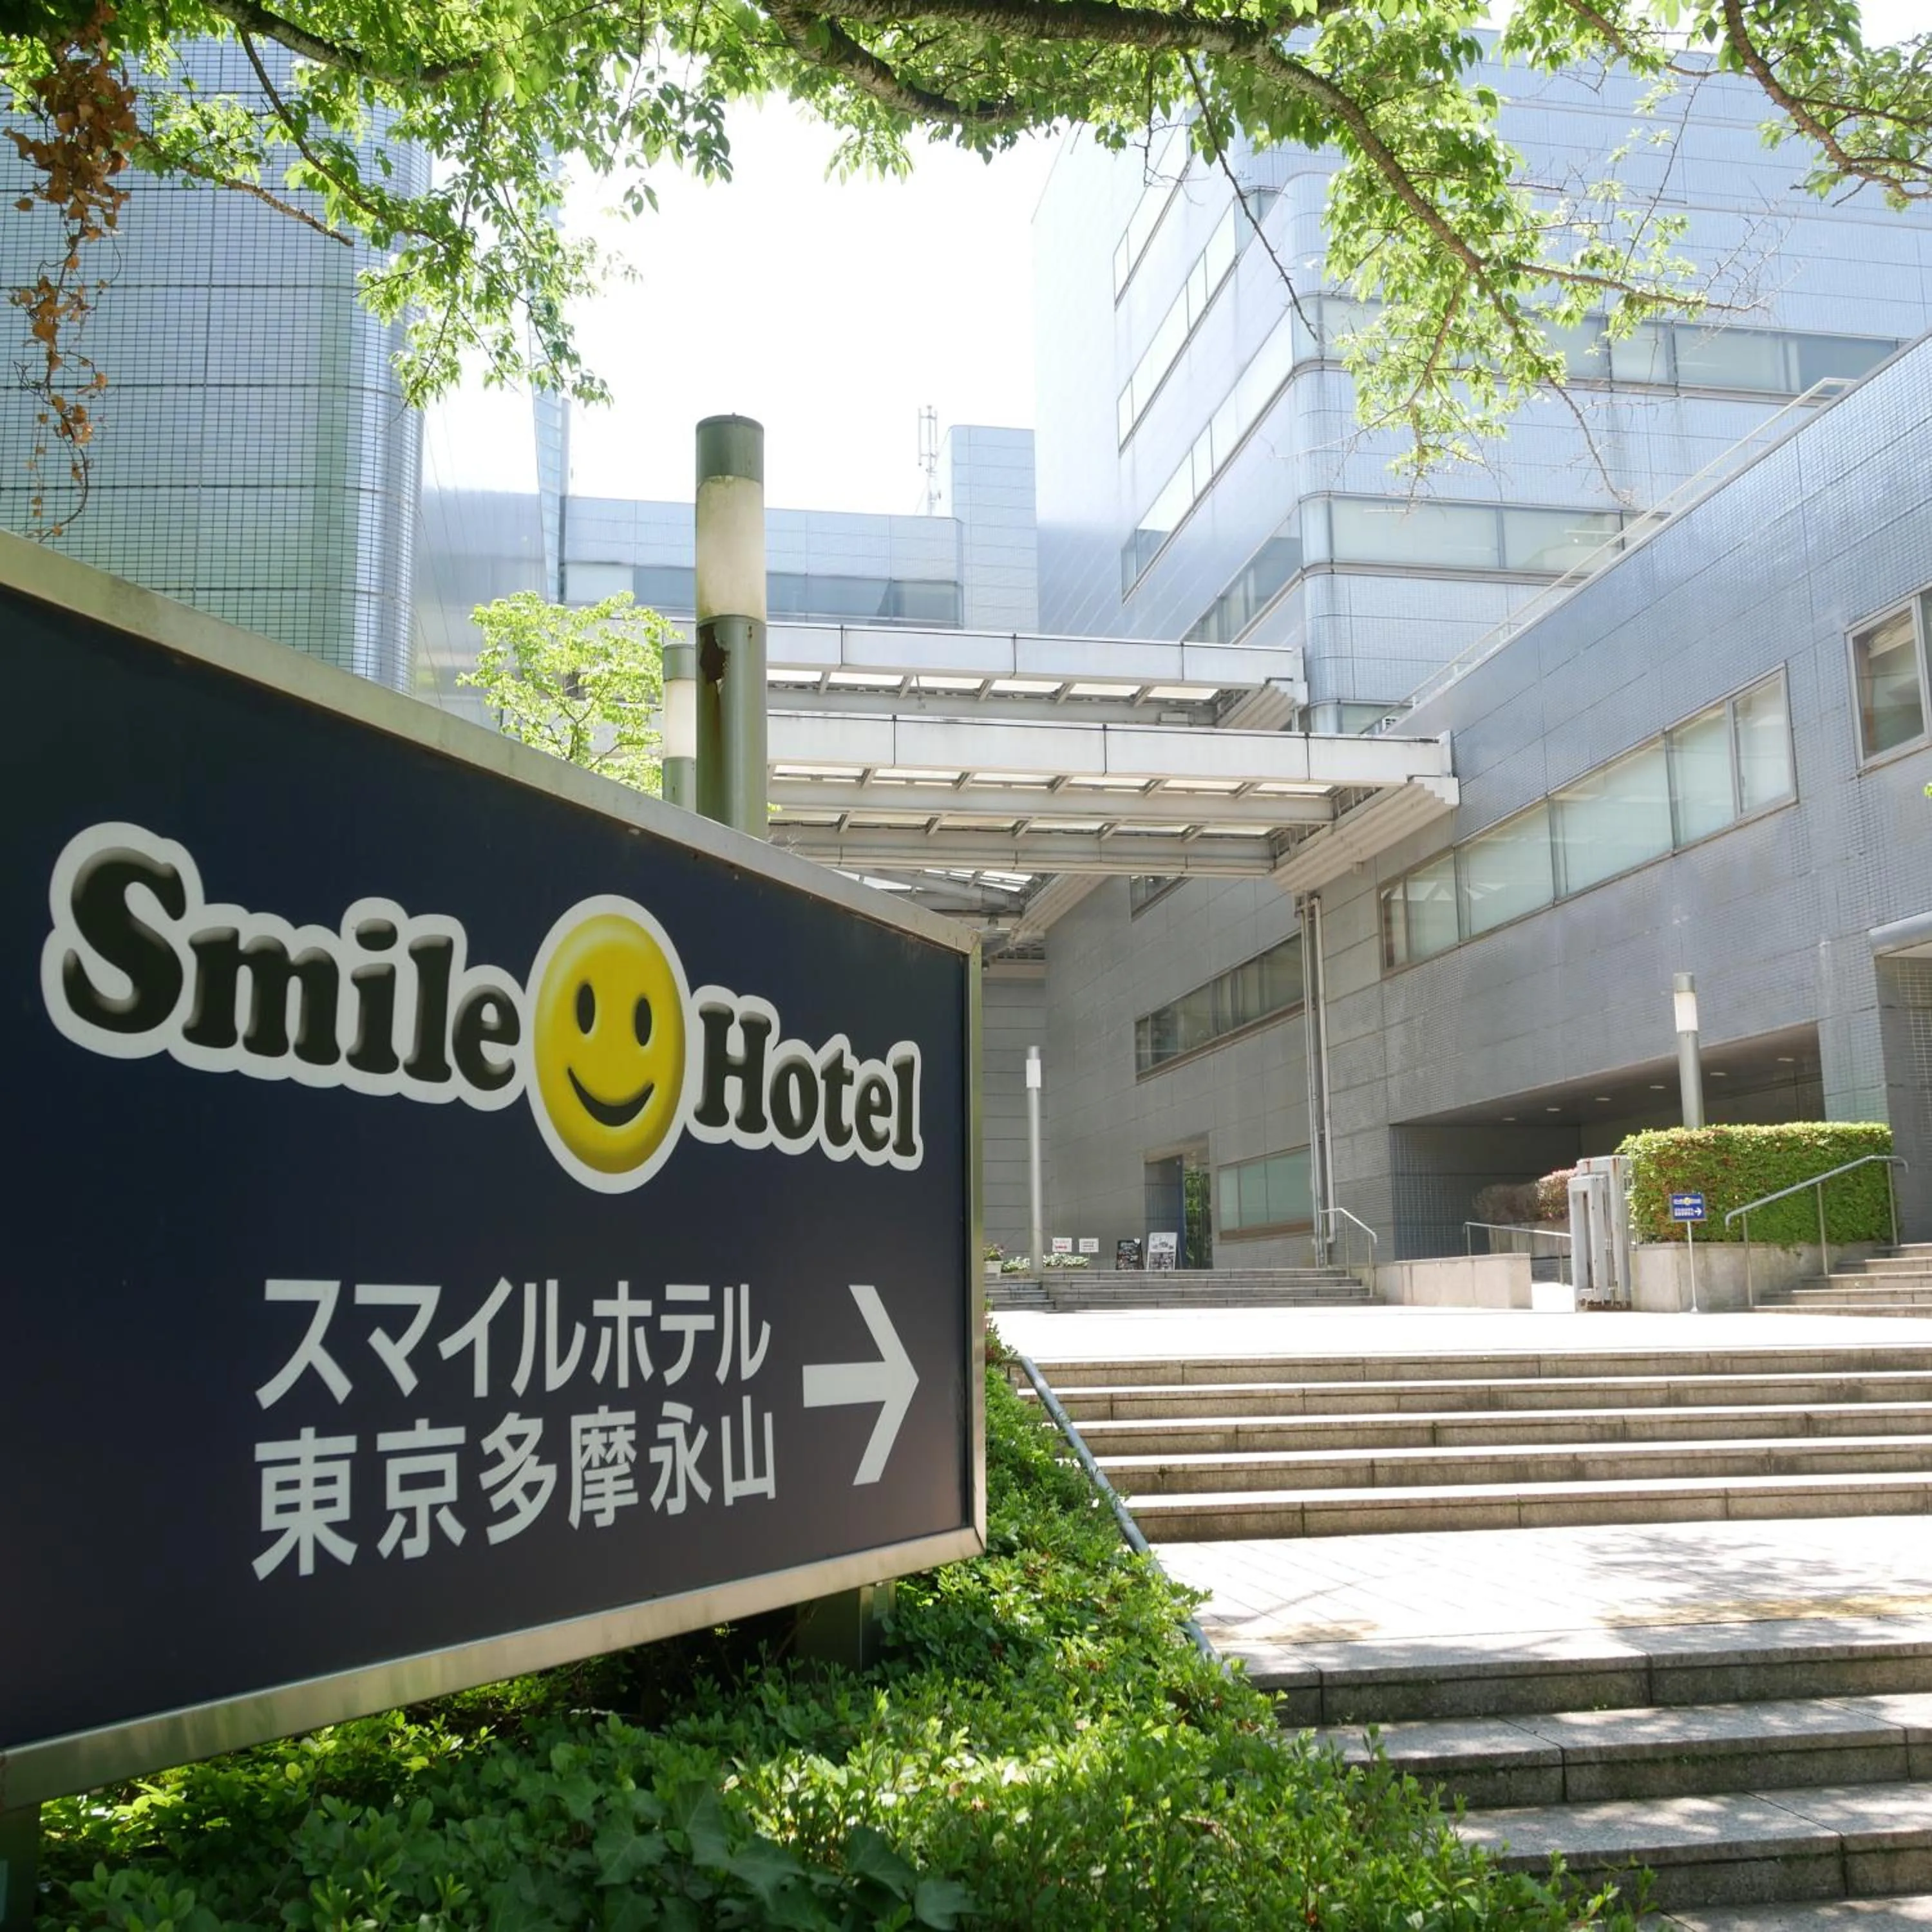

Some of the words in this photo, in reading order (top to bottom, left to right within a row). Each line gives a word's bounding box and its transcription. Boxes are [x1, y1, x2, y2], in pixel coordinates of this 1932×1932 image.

[62, 846, 518, 1090] Smile
[694, 1001, 919, 1159] Hotel
[254, 1278, 772, 1409] スマイルホテル
[251, 1395, 777, 1580] 東京多摩永山
